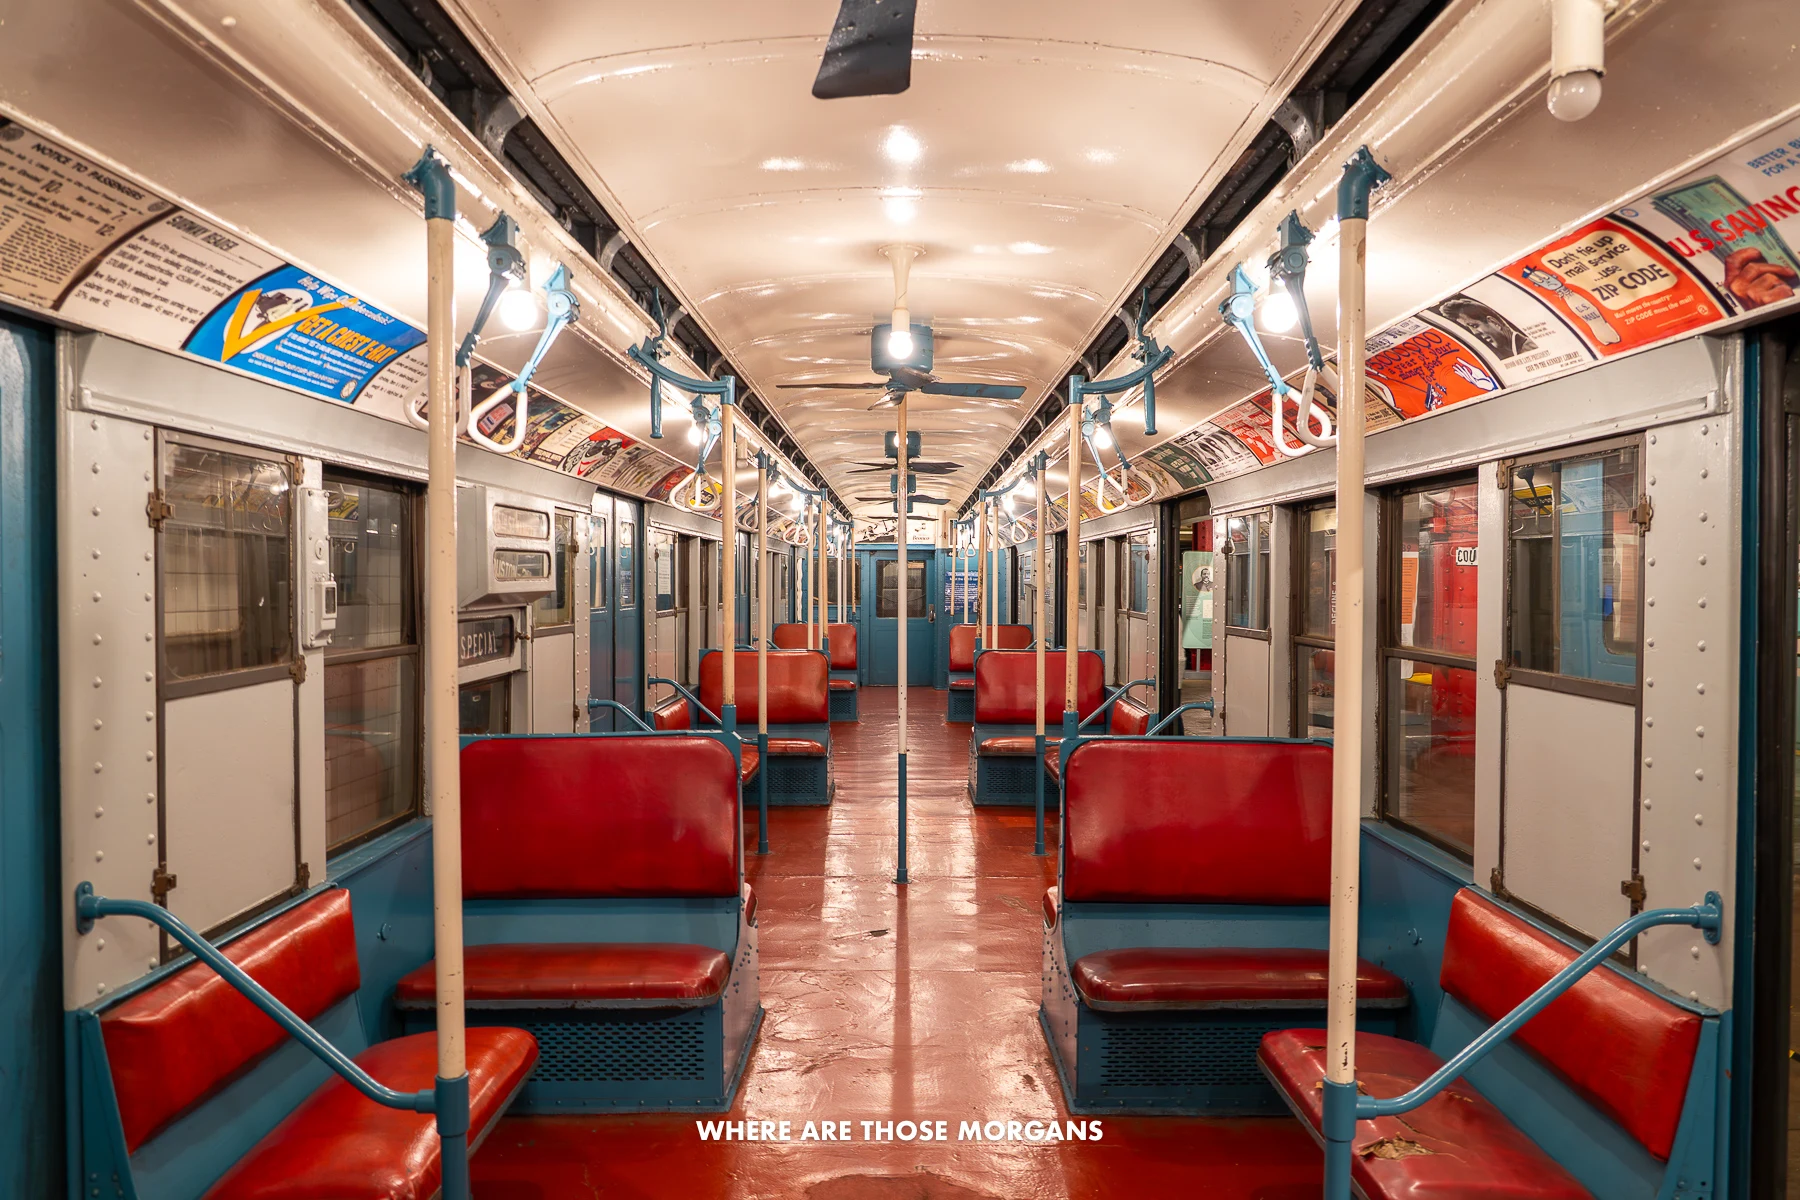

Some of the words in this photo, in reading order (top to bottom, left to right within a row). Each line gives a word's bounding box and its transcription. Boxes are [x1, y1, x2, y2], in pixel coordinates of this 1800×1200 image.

[1746, 148, 1789, 169] BETTER
[1762, 163, 1789, 177] FOR
[32, 143, 72, 164] NOTICE
[72, 162, 88, 172] TO
[88, 171, 145, 200] PASSENGERS
[166, 215, 210, 237] SUBWAY
[202, 231, 238, 251] READER
[1667, 230, 1722, 257] U.S.
[1548, 252, 1579, 268] Don't
[1576, 247, 1597, 257] tie
[1593, 236, 1614, 247] up
[1564, 262, 1590, 277] mail
[1588, 244, 1630, 266] service
[297, 276, 320, 291] Help
[317, 284, 338, 300] Wipe
[1592, 284, 1620, 301] ZIP
[1618, 264, 1669, 290] CODE
[1582, 312, 1600, 322] MAIL
[1636, 310, 1653, 321] CODE
[1654, 306, 1668, 314] moves
[1668, 301, 1678, 309] the
[296, 314, 333, 337] GET
[316, 323, 339, 340] A
[326, 327, 372, 353] CHEST
[356, 340, 398, 364] X-RAY
[1394, 359, 1417, 372] year
[1429, 343, 1452, 360] your
[1457, 550, 1476, 562] COU
[460, 631, 497, 659] SPECIAL
